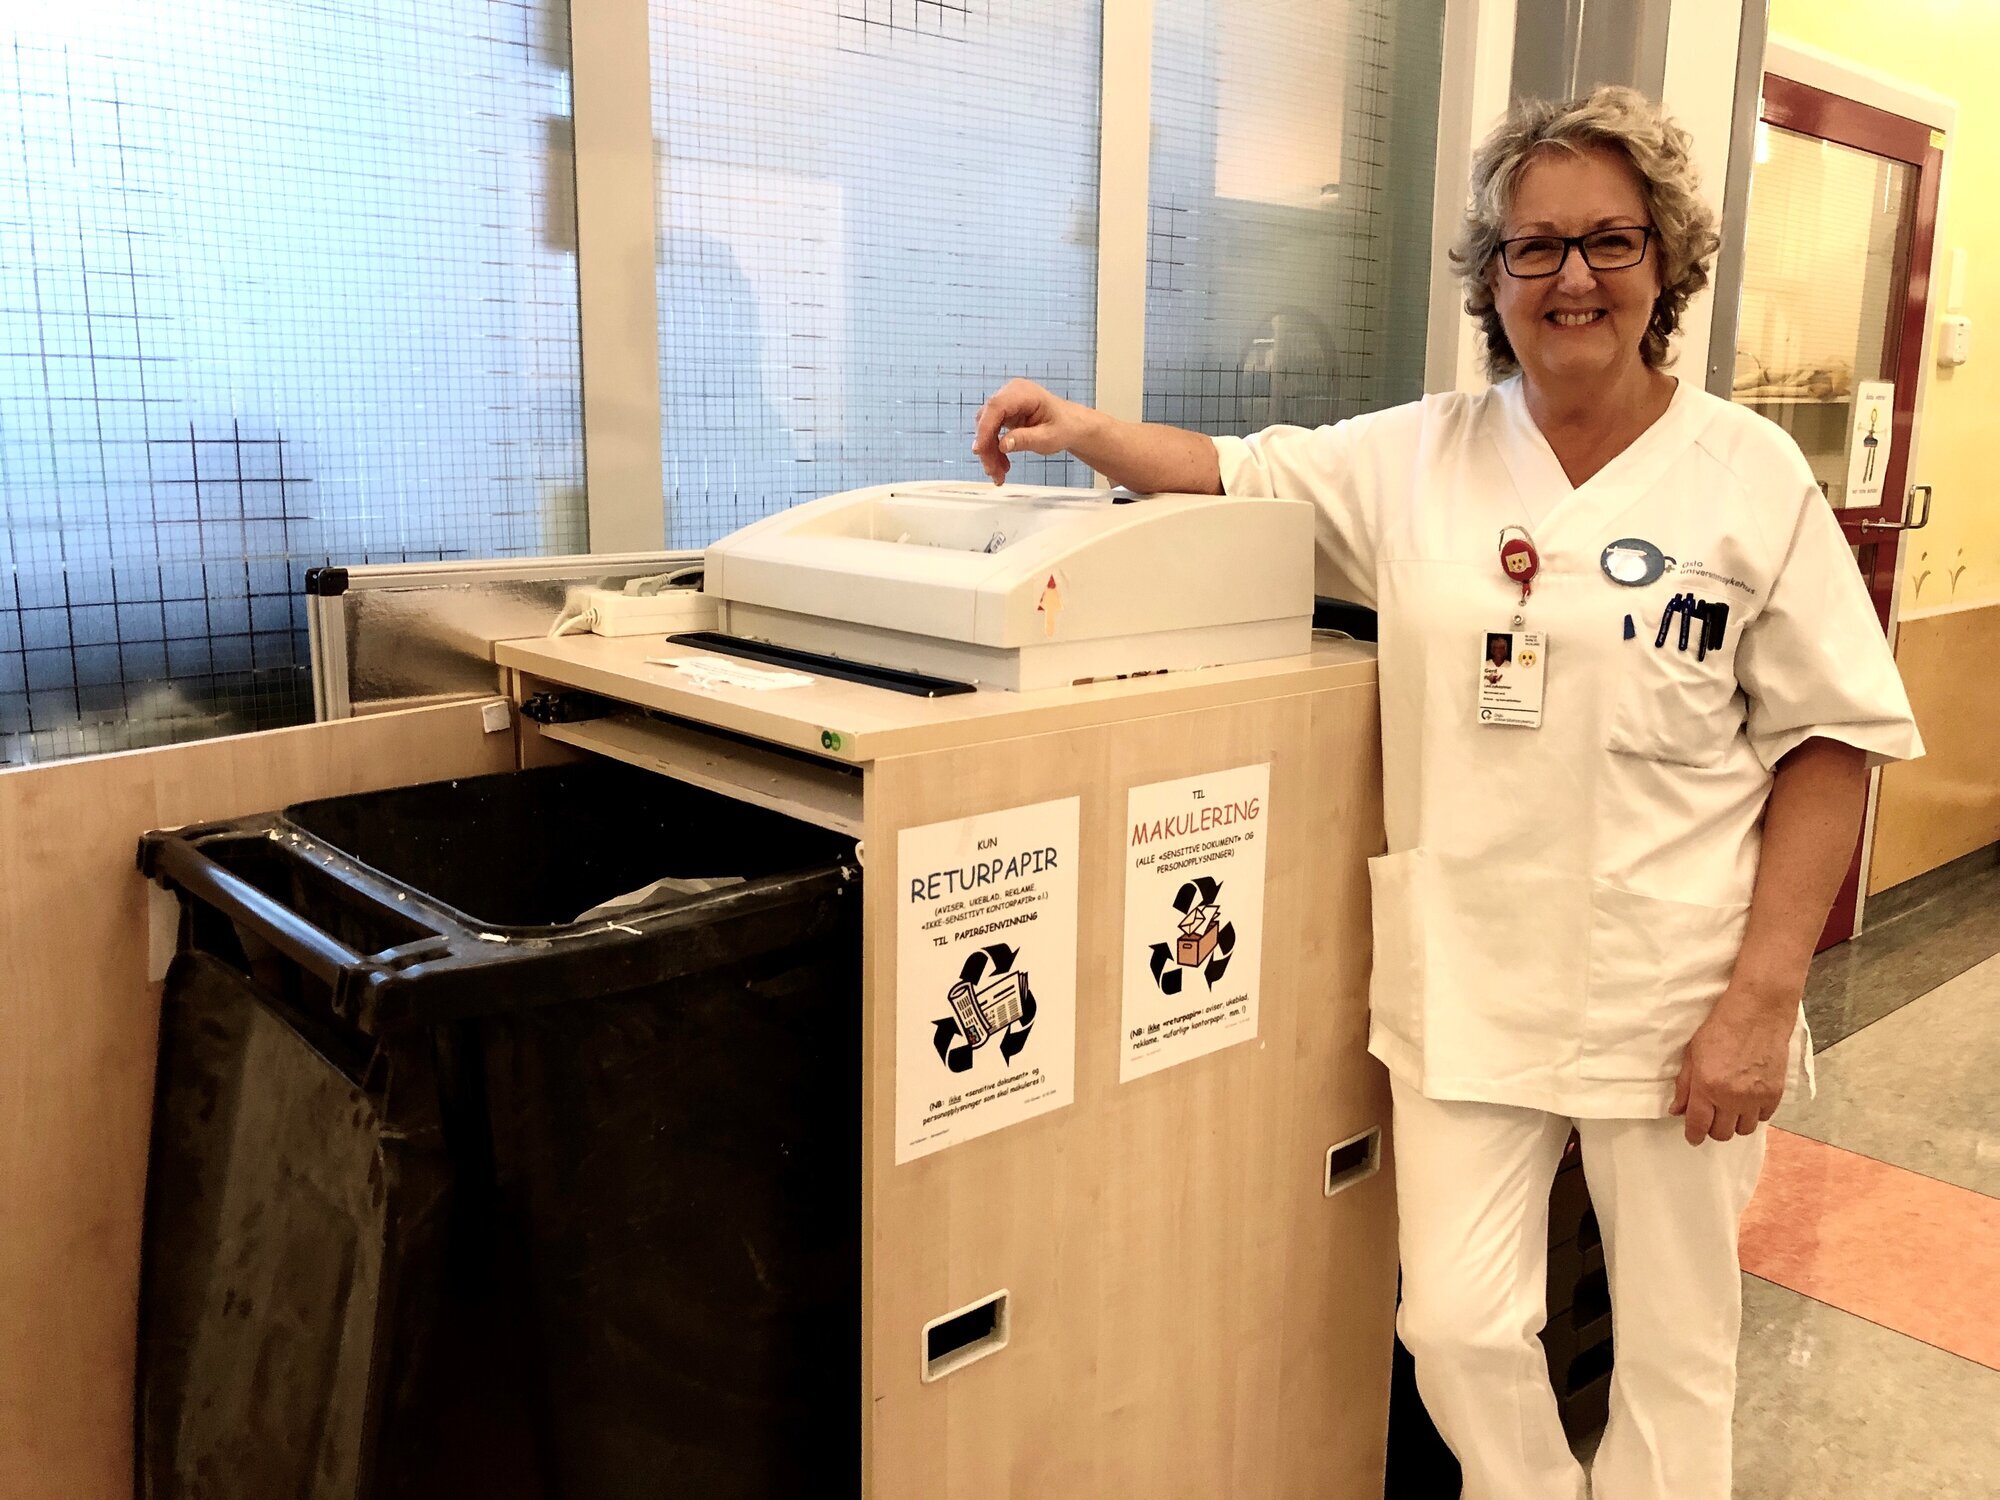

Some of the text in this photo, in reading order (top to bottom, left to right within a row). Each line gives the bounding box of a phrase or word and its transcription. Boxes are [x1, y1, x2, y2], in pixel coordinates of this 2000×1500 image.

[1192, 790, 1205, 799] TIL
[1131, 797, 1260, 847] MAKULERING
[977, 837, 998, 850] KUN
[1136, 832, 1254, 868] (ALLE «SENSITIVE DOKUMENT» OG
[911, 847, 1058, 904] RETURPAPIR
[1157, 848, 1235, 874] PERSONOPPLYSNINGER)
[933, 911, 1038, 947] TIL PAPIRGJENVINNING
[1147, 1023, 1160, 1034] ikke
[922, 1098, 982, 1126] personopplysninger
[983, 1095, 996, 1103] som
[997, 1087, 1009, 1098] skal
[1010, 1078, 1040, 1093] makuleres
[948, 1094, 962, 1106] ikke
